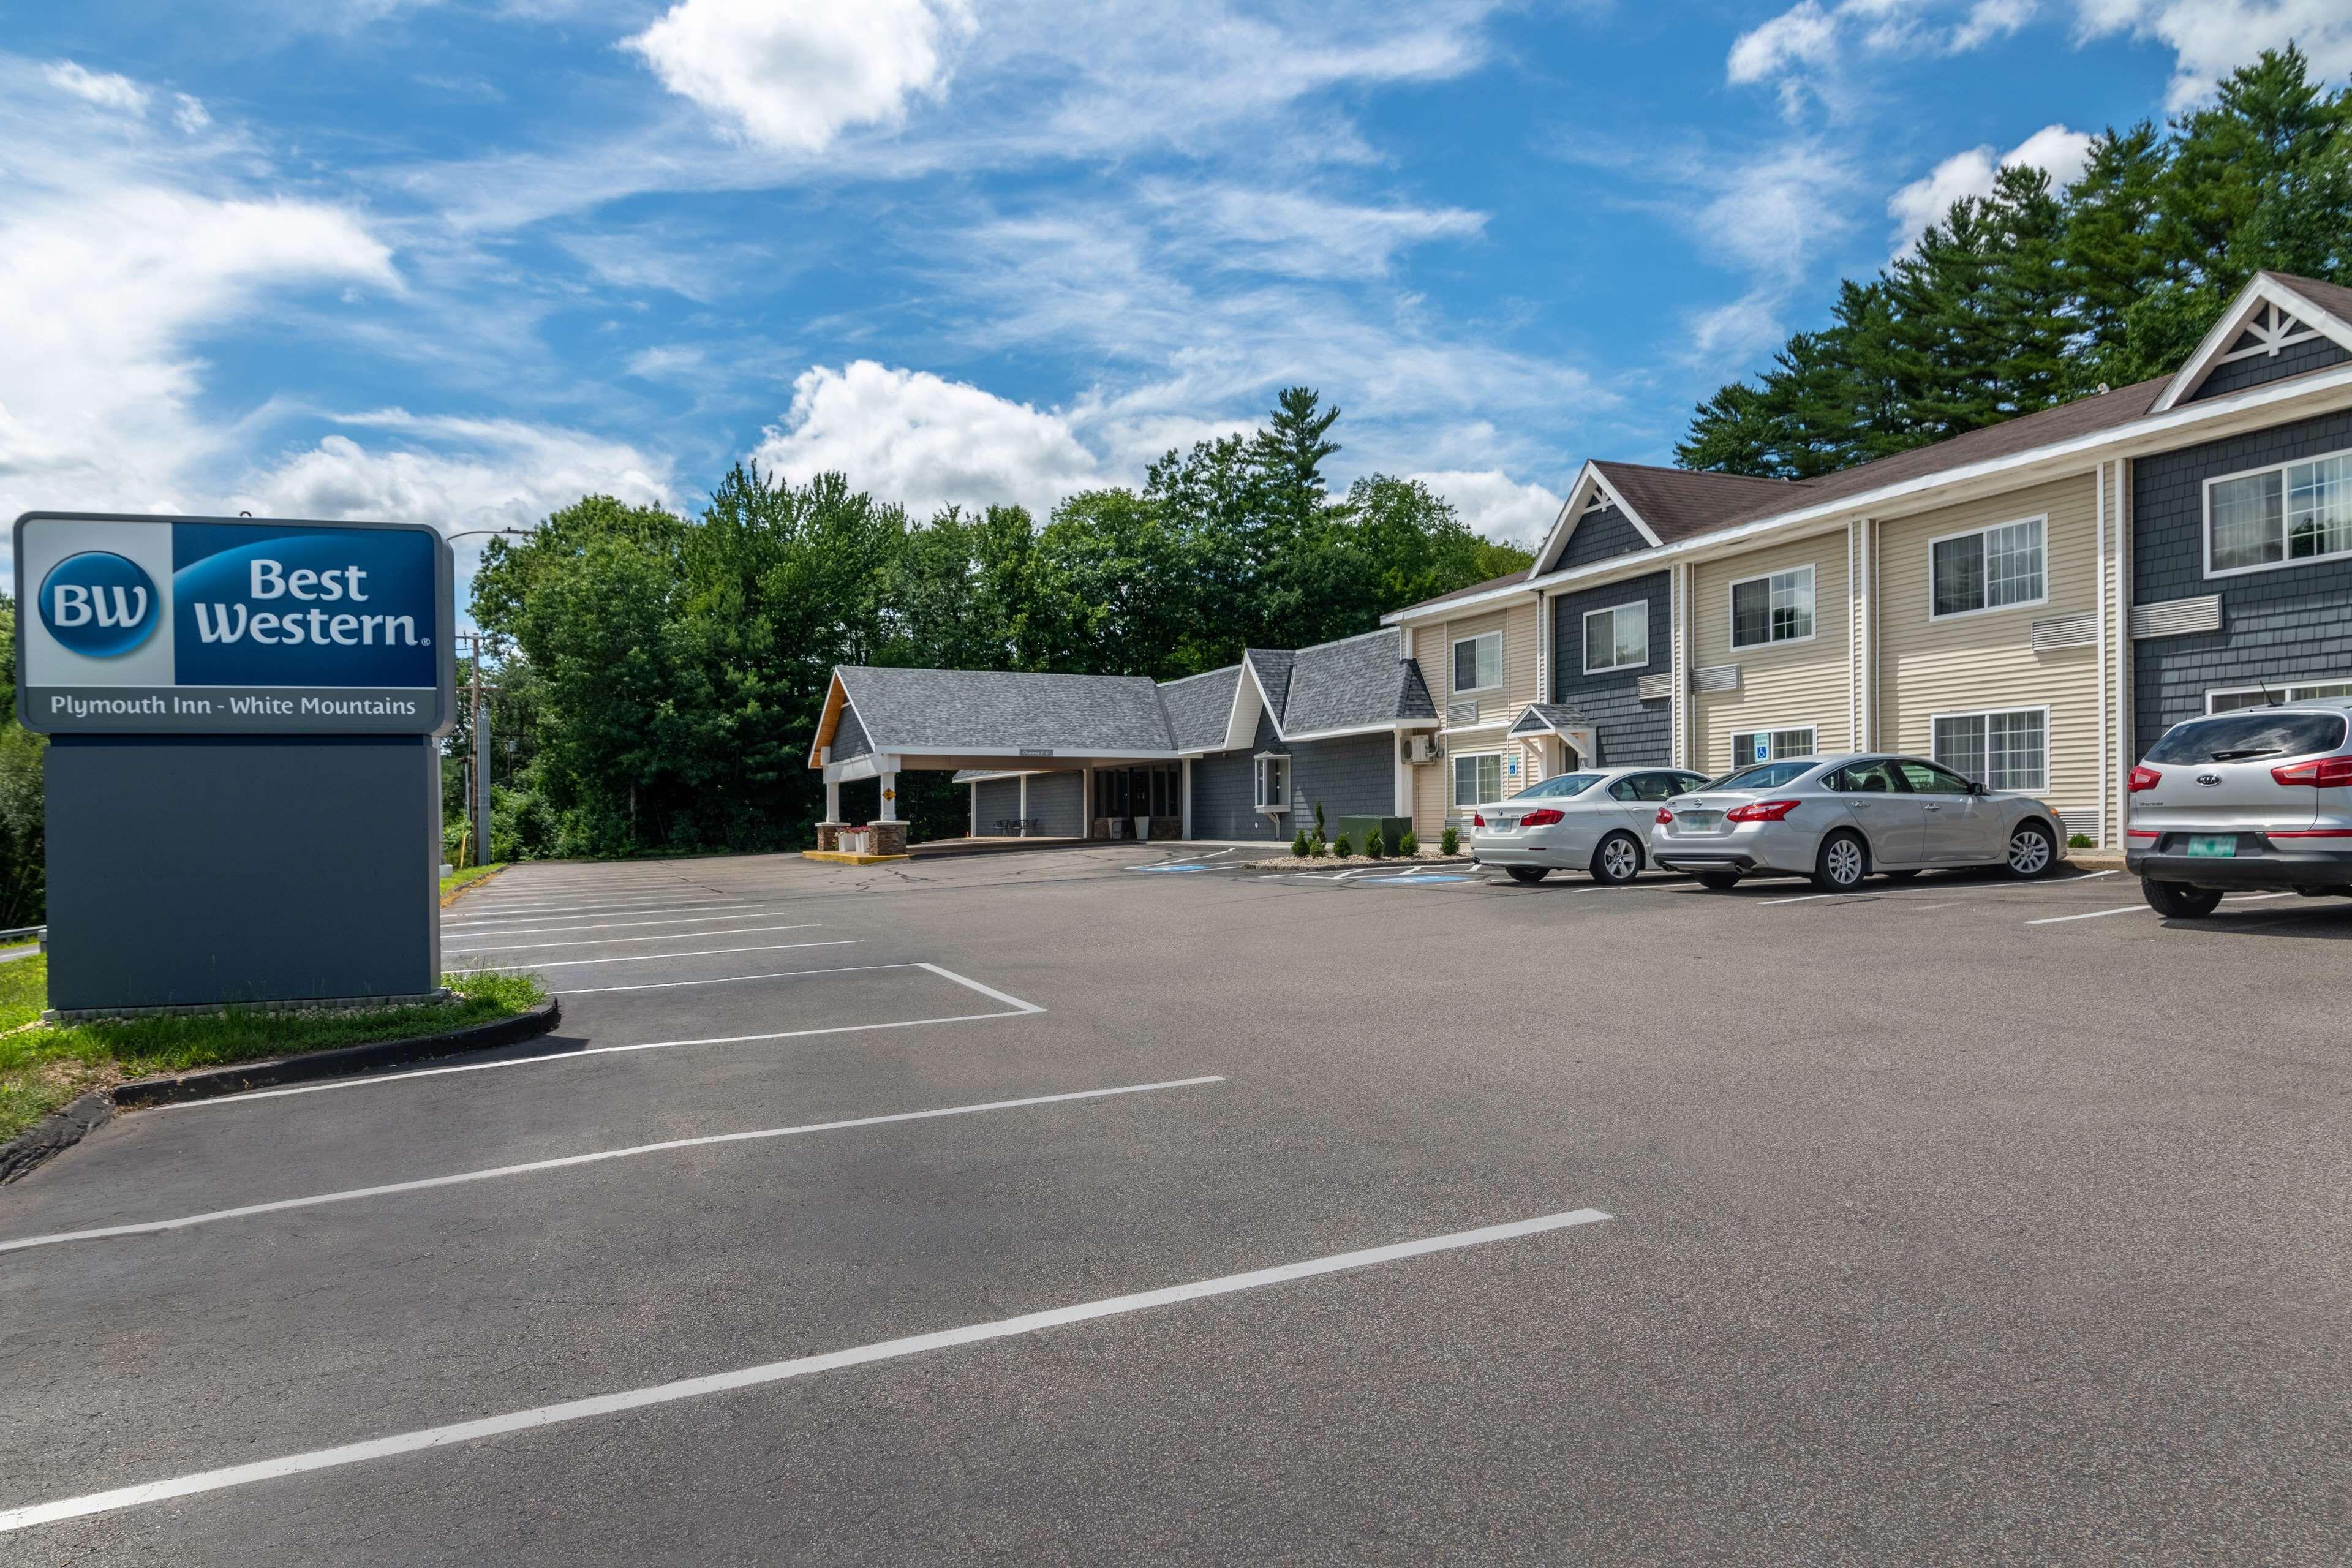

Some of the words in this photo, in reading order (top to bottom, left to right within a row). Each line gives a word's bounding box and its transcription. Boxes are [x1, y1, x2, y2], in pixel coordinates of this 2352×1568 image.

[251, 559, 369, 601] Best
[54, 584, 147, 627] BW
[51, 695, 166, 718] Plymouth
[174, 696, 212, 714] Inn
[230, 696, 293, 714] White
[301, 696, 416, 715] Mountains
